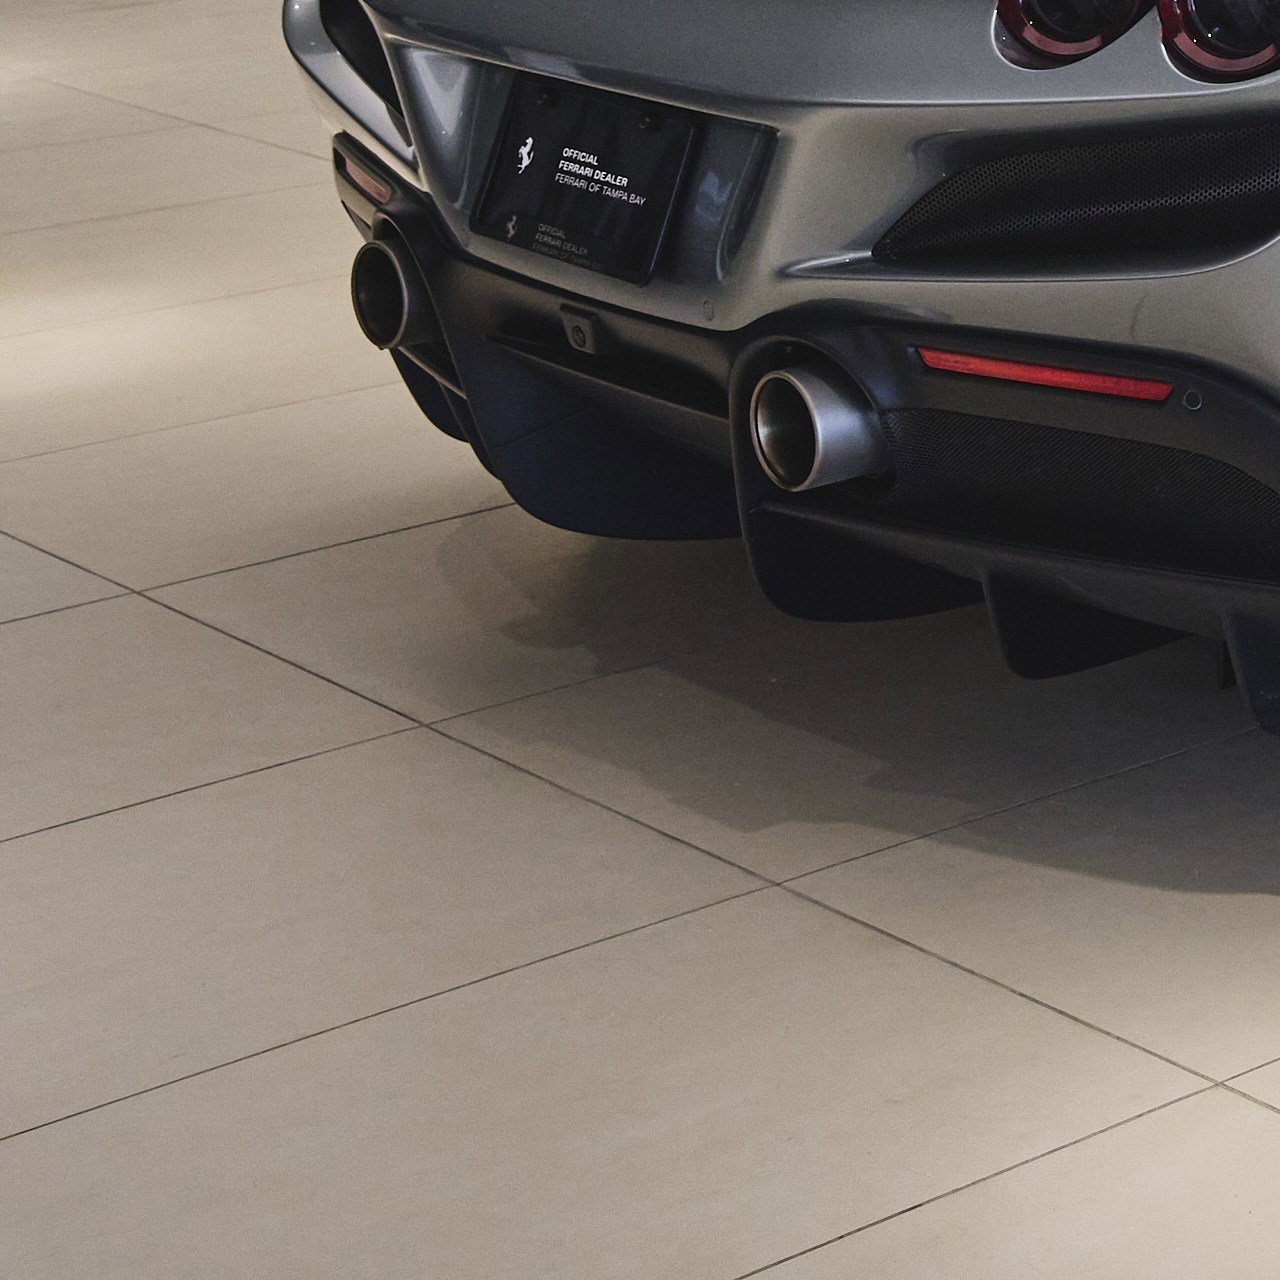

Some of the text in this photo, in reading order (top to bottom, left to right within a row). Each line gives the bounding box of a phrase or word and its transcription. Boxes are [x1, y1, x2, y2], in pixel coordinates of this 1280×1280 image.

[562, 147, 598, 166] OFFICIAL
[558, 160, 629, 187] FERRARI DEALER
[555, 173, 647, 206] FERRARI OF TAMPA BAY
